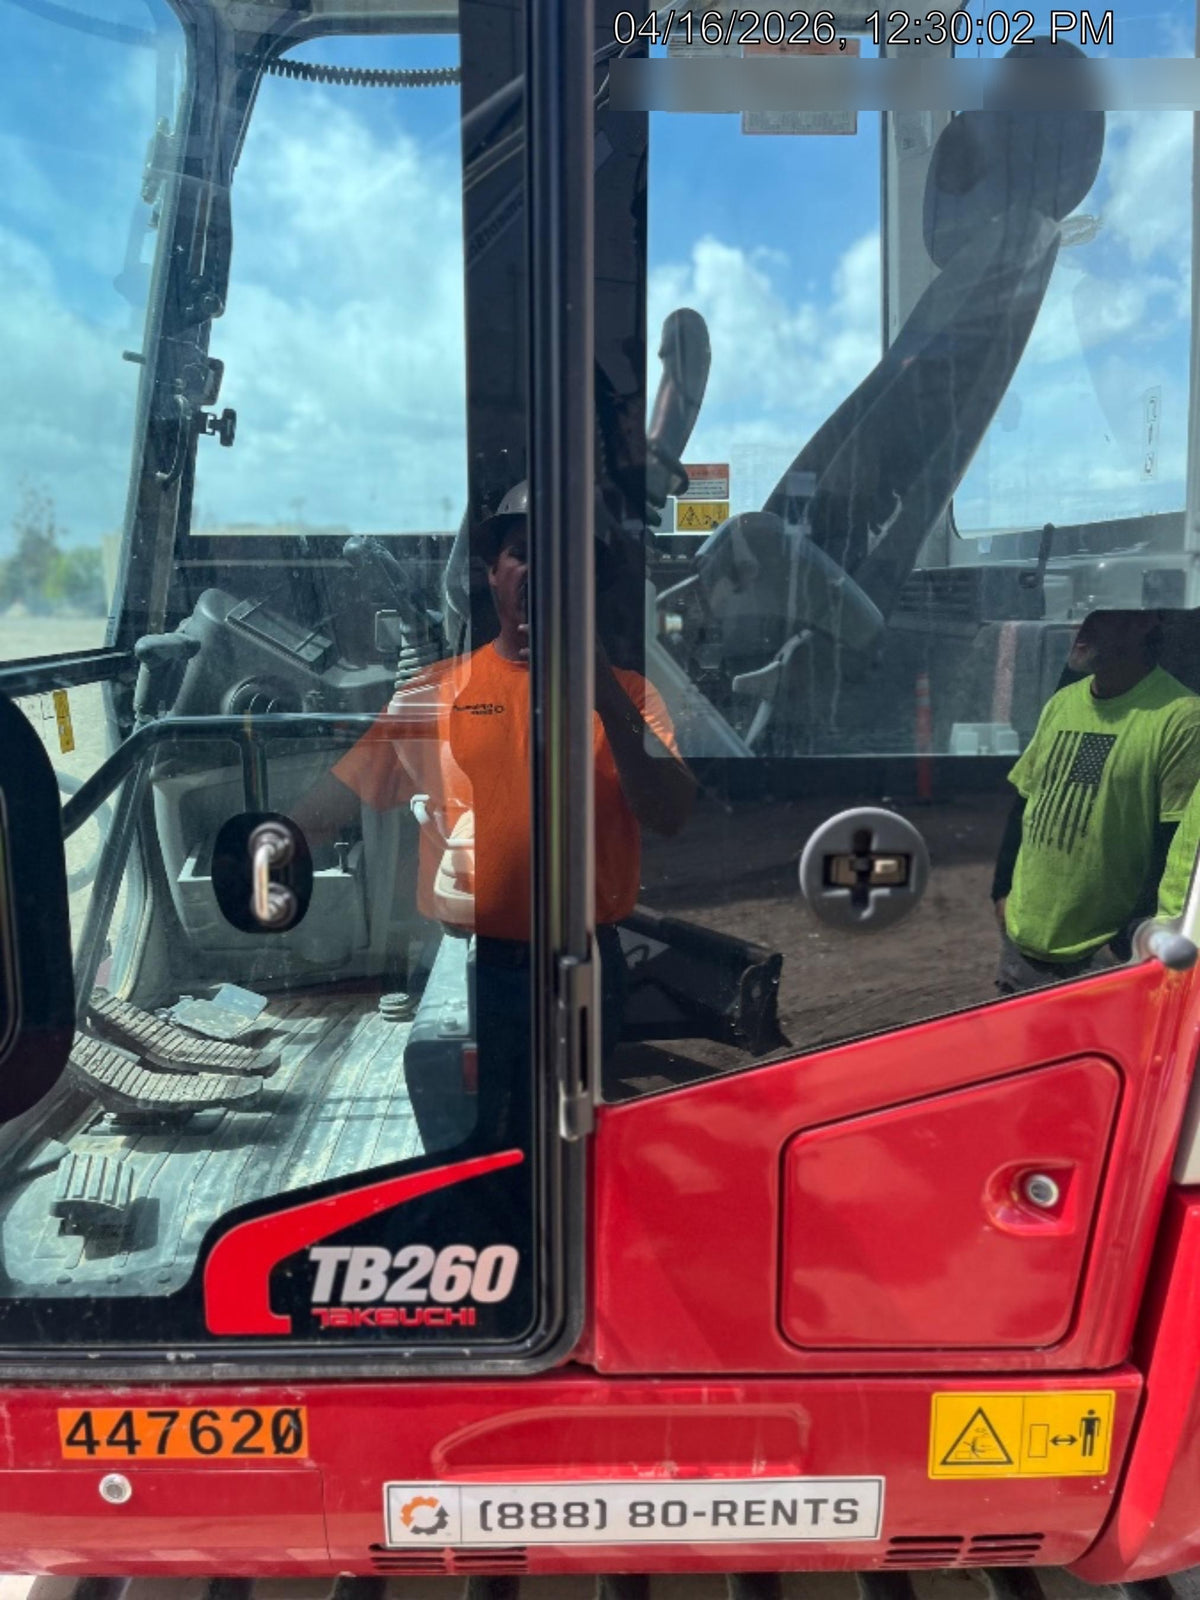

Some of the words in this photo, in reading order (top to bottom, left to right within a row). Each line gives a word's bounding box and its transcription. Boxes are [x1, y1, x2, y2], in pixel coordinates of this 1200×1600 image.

[309, 1244, 519, 1303] TB260
[65, 1408, 303, 1455] 447620
[479, 1499, 607, 1530] (888)
[628, 1497, 859, 1528] 80-RENTS
